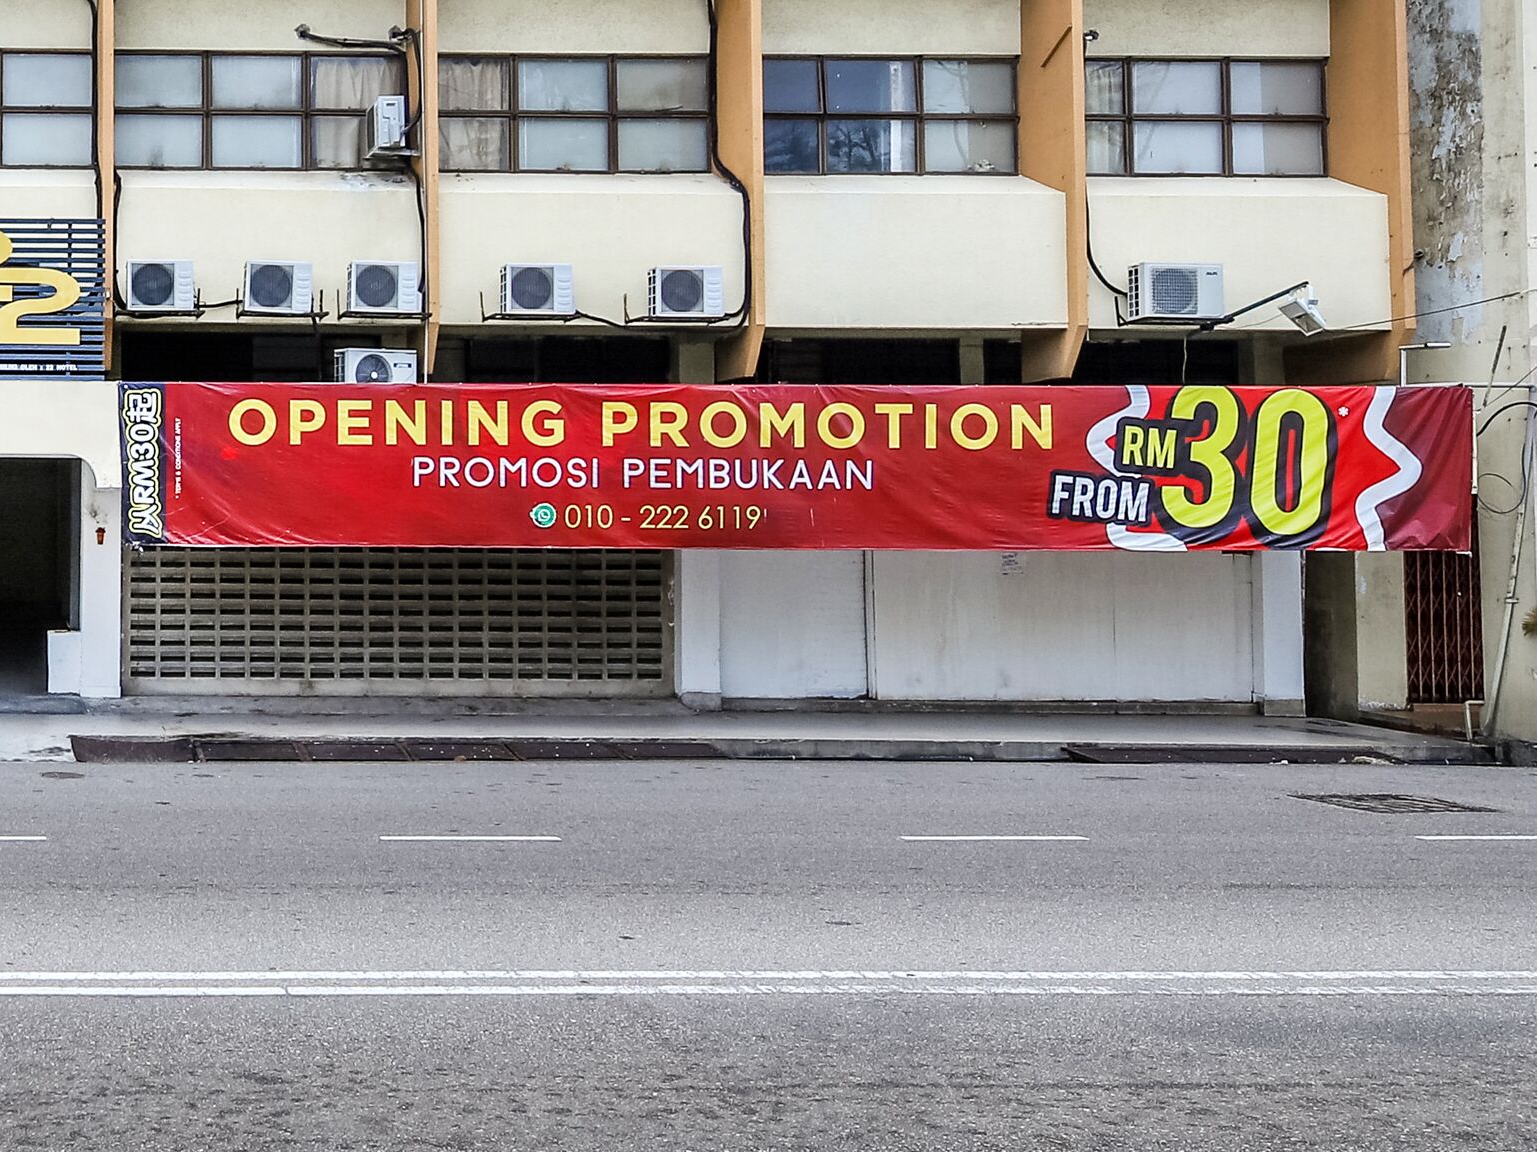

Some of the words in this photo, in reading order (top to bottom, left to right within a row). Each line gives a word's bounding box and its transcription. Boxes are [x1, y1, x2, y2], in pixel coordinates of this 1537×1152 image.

[228, 398, 565, 447] OPENING
[601, 400, 1053, 451] PROMOTION
[1122, 423, 1177, 471] RM
[411, 457, 600, 489] PROMOSI
[621, 457, 873, 491] PEMBUKAAN
[564, 504, 613, 529] 010
[639, 505, 689, 530] 222
[696, 505, 760, 530] 6119
[1051, 474, 1150, 524] FROM
